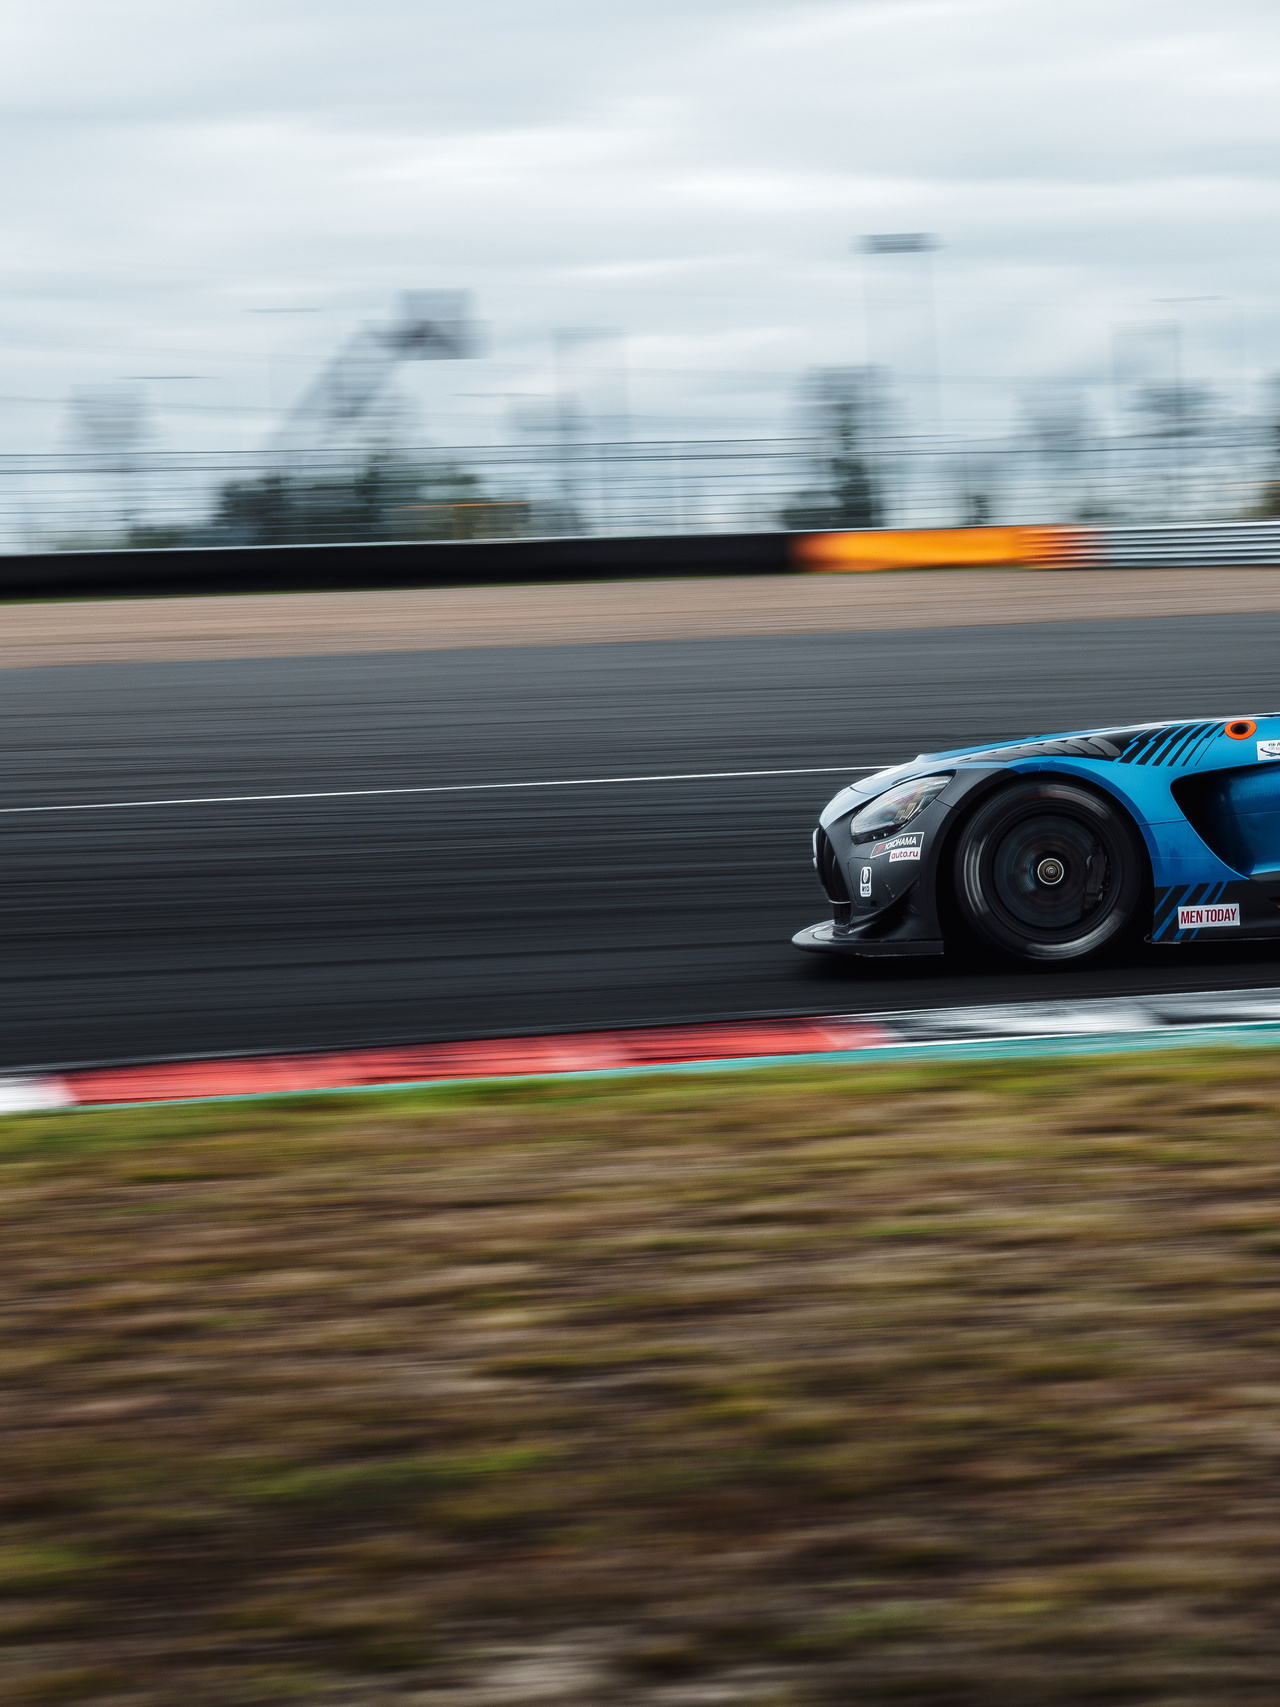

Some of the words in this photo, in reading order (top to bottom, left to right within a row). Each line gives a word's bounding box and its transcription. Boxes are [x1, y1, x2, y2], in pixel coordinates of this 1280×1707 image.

[891, 850, 919, 859] auto.ru
[1181, 910, 1203, 924] MEN
[1205, 908, 1237, 922] TODAY
